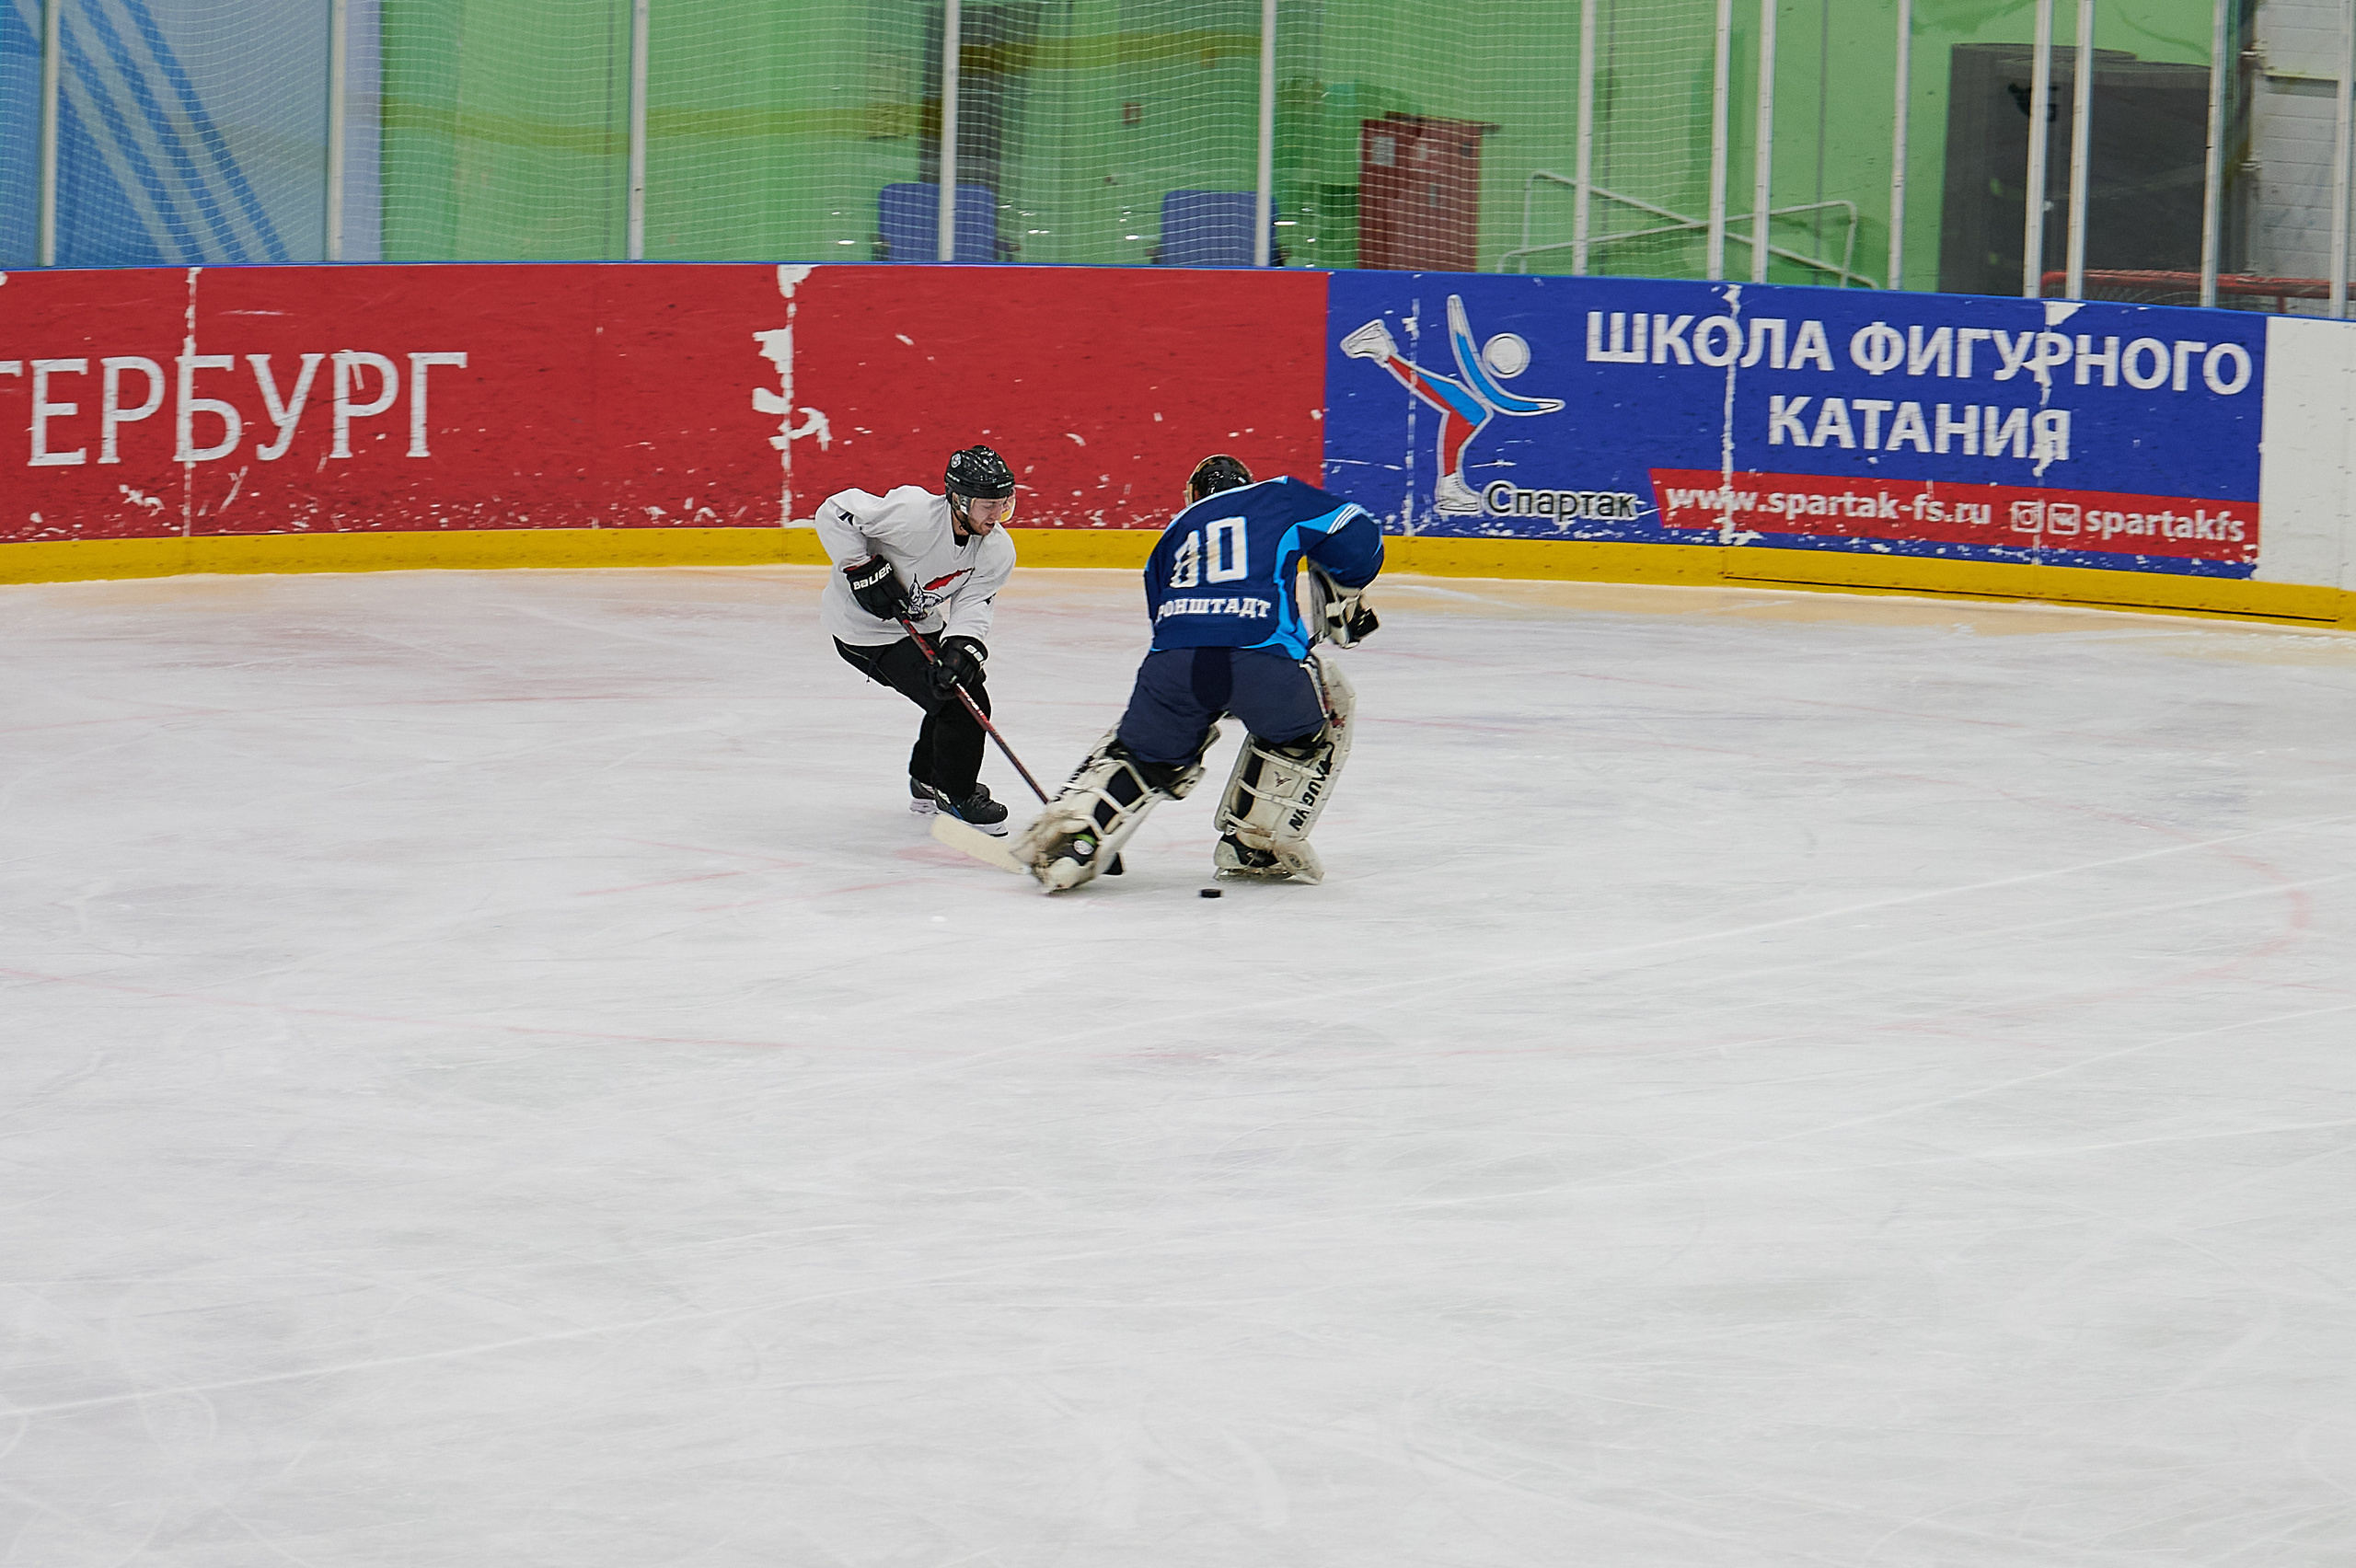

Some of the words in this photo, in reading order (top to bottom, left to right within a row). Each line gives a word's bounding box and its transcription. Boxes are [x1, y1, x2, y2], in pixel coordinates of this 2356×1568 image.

[1586, 310, 1835, 372] ШКОЛА
[1849, 320, 2254, 396] ФИГУРНОГО
[1768, 395, 2073, 462] КАТАНИЯ
[1484, 481, 1636, 525] Спартак
[1664, 487, 1992, 526] www.spartak-fs.ru
[2084, 508, 2246, 543] spartakfs
